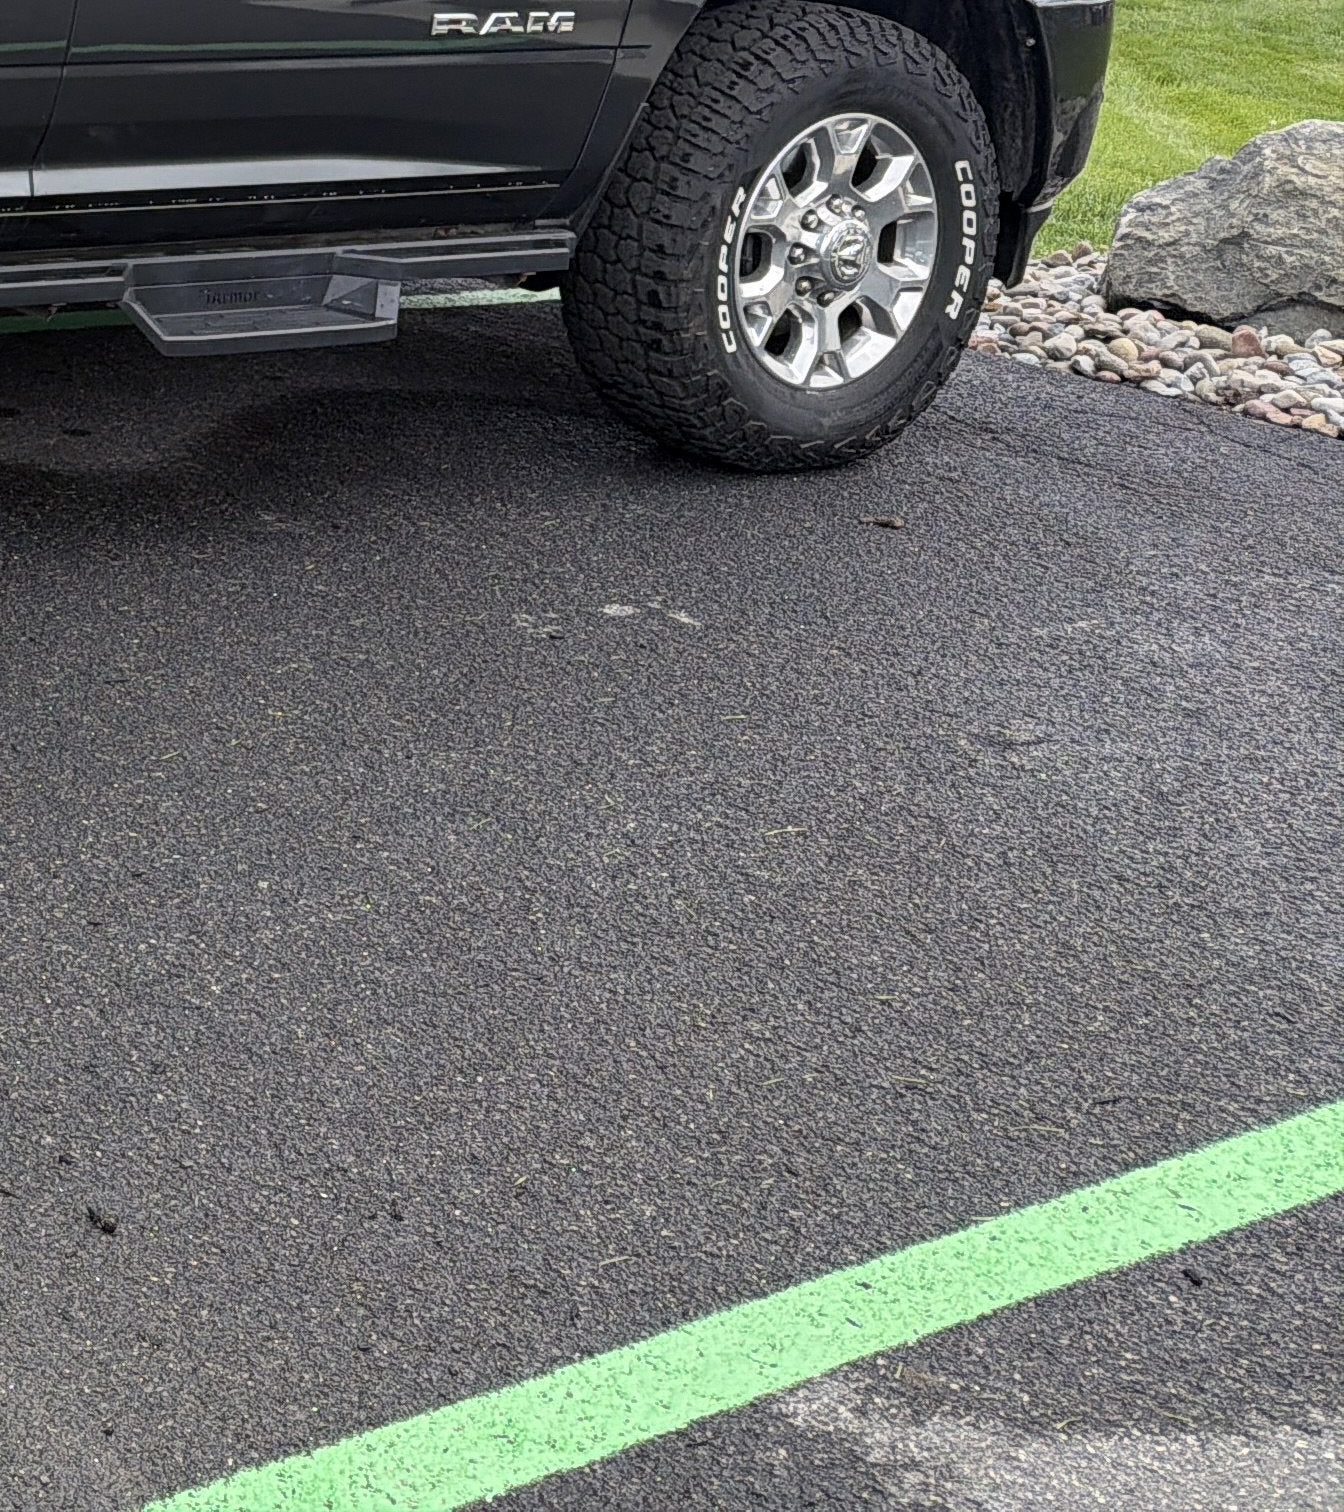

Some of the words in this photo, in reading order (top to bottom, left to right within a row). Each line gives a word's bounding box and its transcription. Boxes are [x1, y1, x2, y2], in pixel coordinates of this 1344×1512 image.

[431, 11, 576, 36] RAM
[717, 186, 747, 355] COOPER
[945, 159, 978, 322] COOPER
